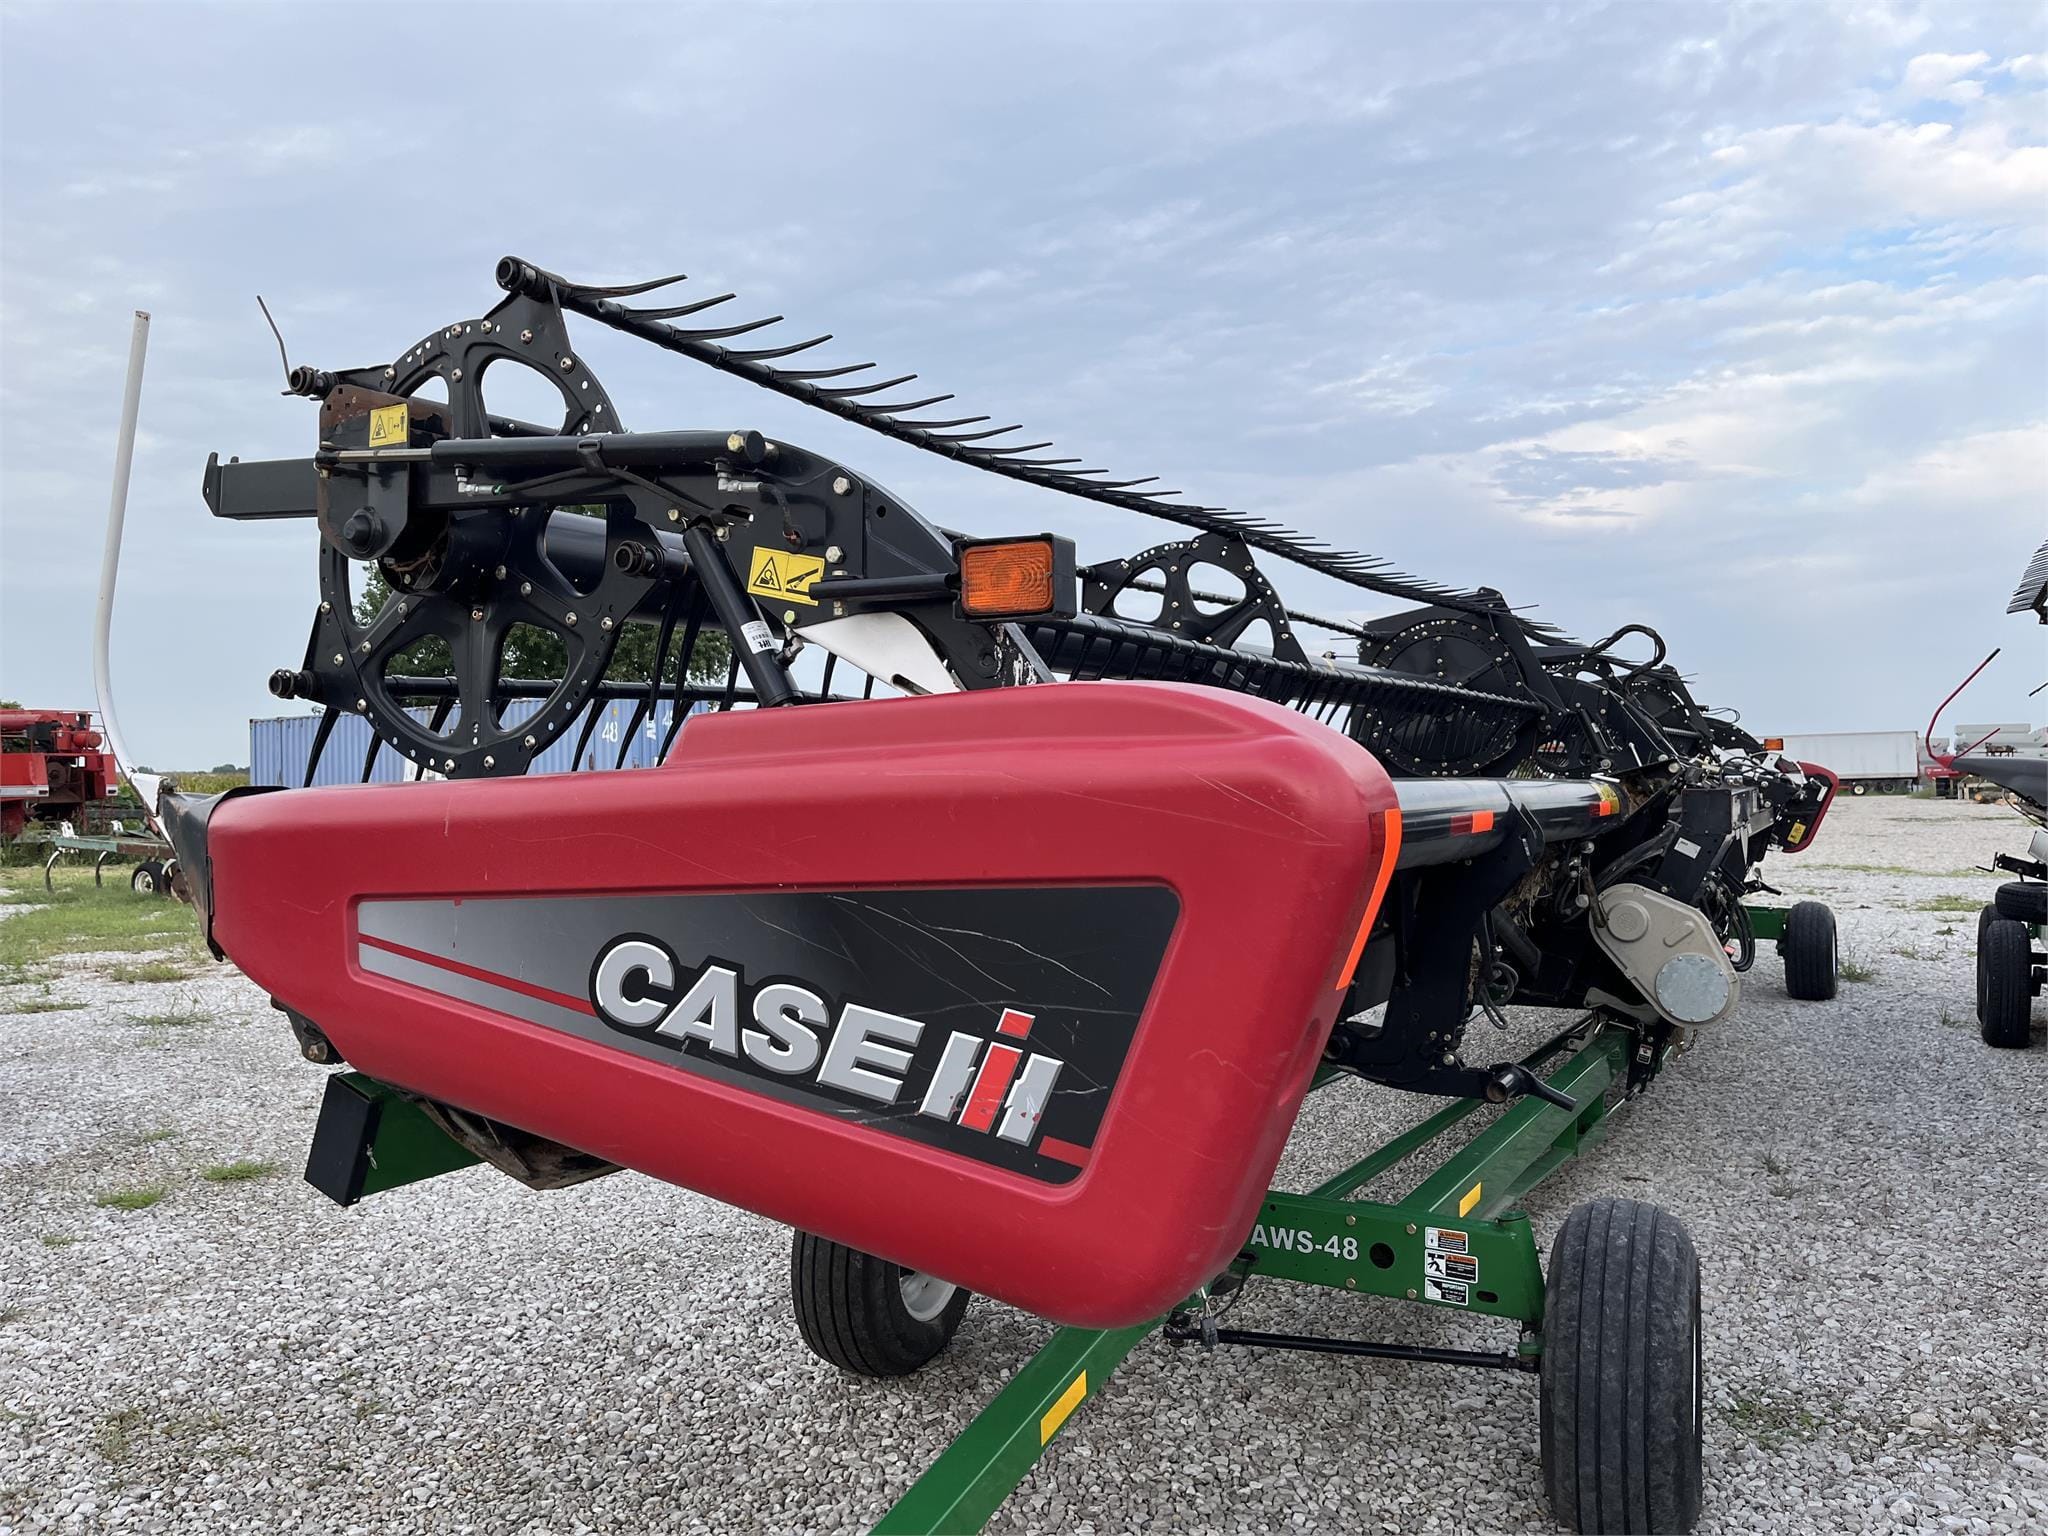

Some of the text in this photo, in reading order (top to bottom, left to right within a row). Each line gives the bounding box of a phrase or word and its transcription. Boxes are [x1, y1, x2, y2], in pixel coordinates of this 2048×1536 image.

[602, 721, 618, 742] 48
[596, 941, 925, 1105] CASE
[1250, 1223, 1359, 1261] AWS-48
